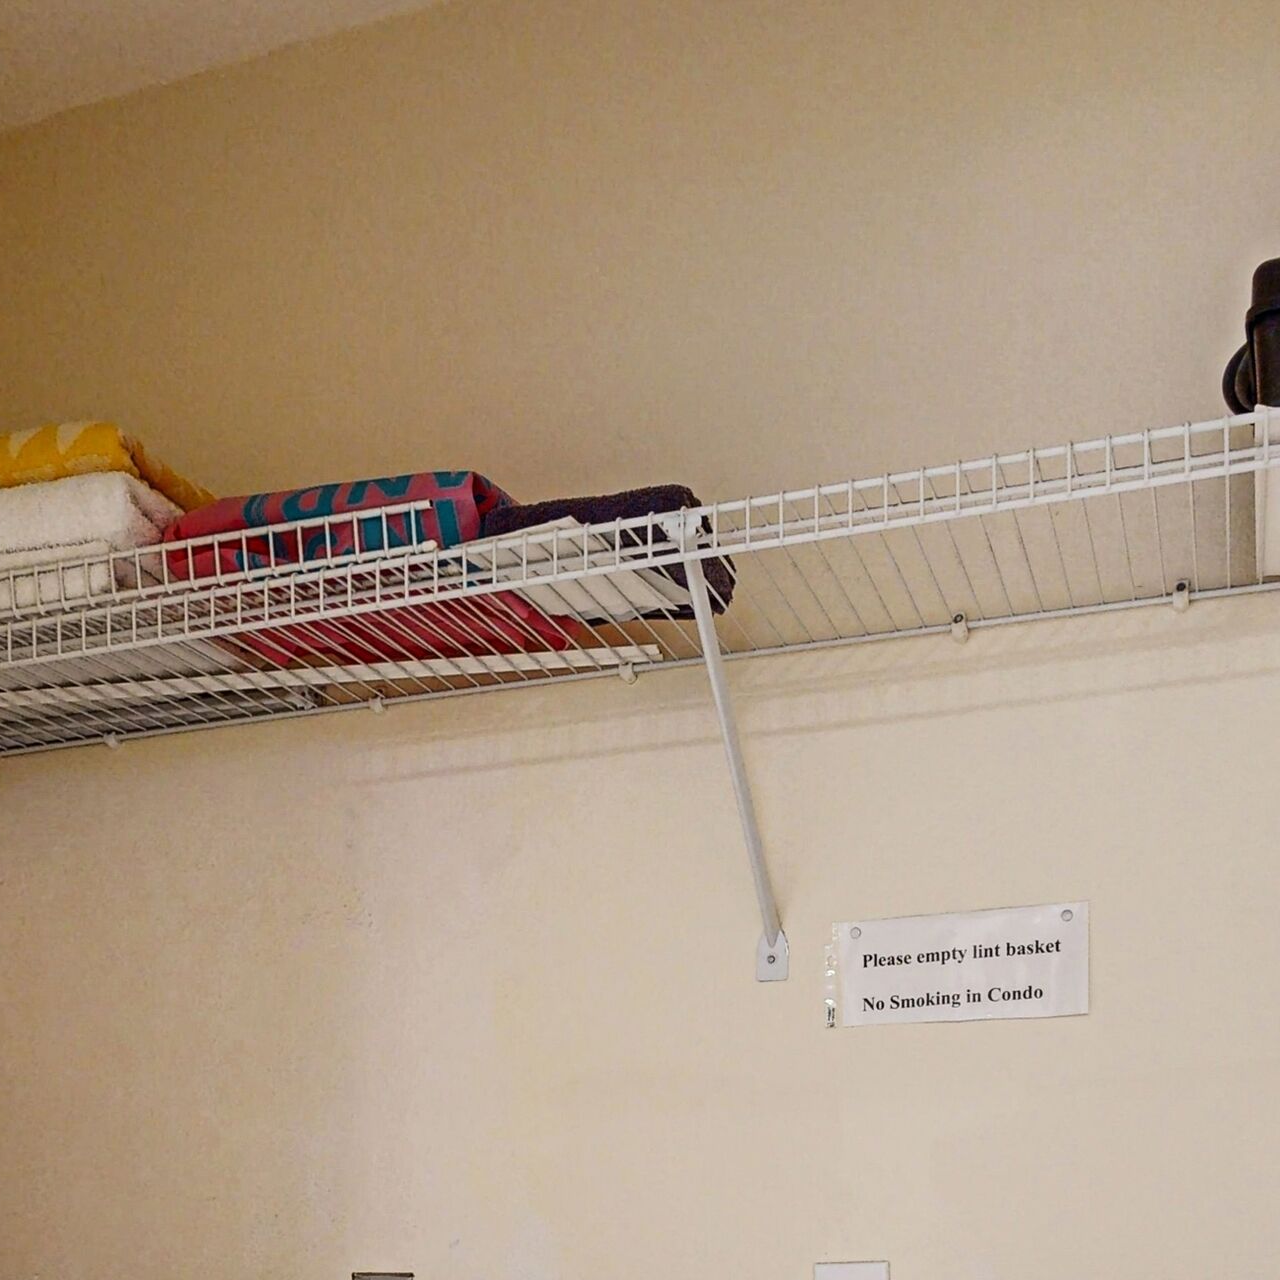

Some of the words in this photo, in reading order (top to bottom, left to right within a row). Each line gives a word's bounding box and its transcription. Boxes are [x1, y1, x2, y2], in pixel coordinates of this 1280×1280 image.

[863, 953, 912, 968] Please
[916, 948, 967, 965] empty
[972, 943, 1000, 959] lint
[1005, 938, 1062, 956] basket
[862, 997, 885, 1012] No
[889, 990, 961, 1010] Smoking
[966, 988, 981, 1003] in
[987, 985, 1043, 1002] Condo
